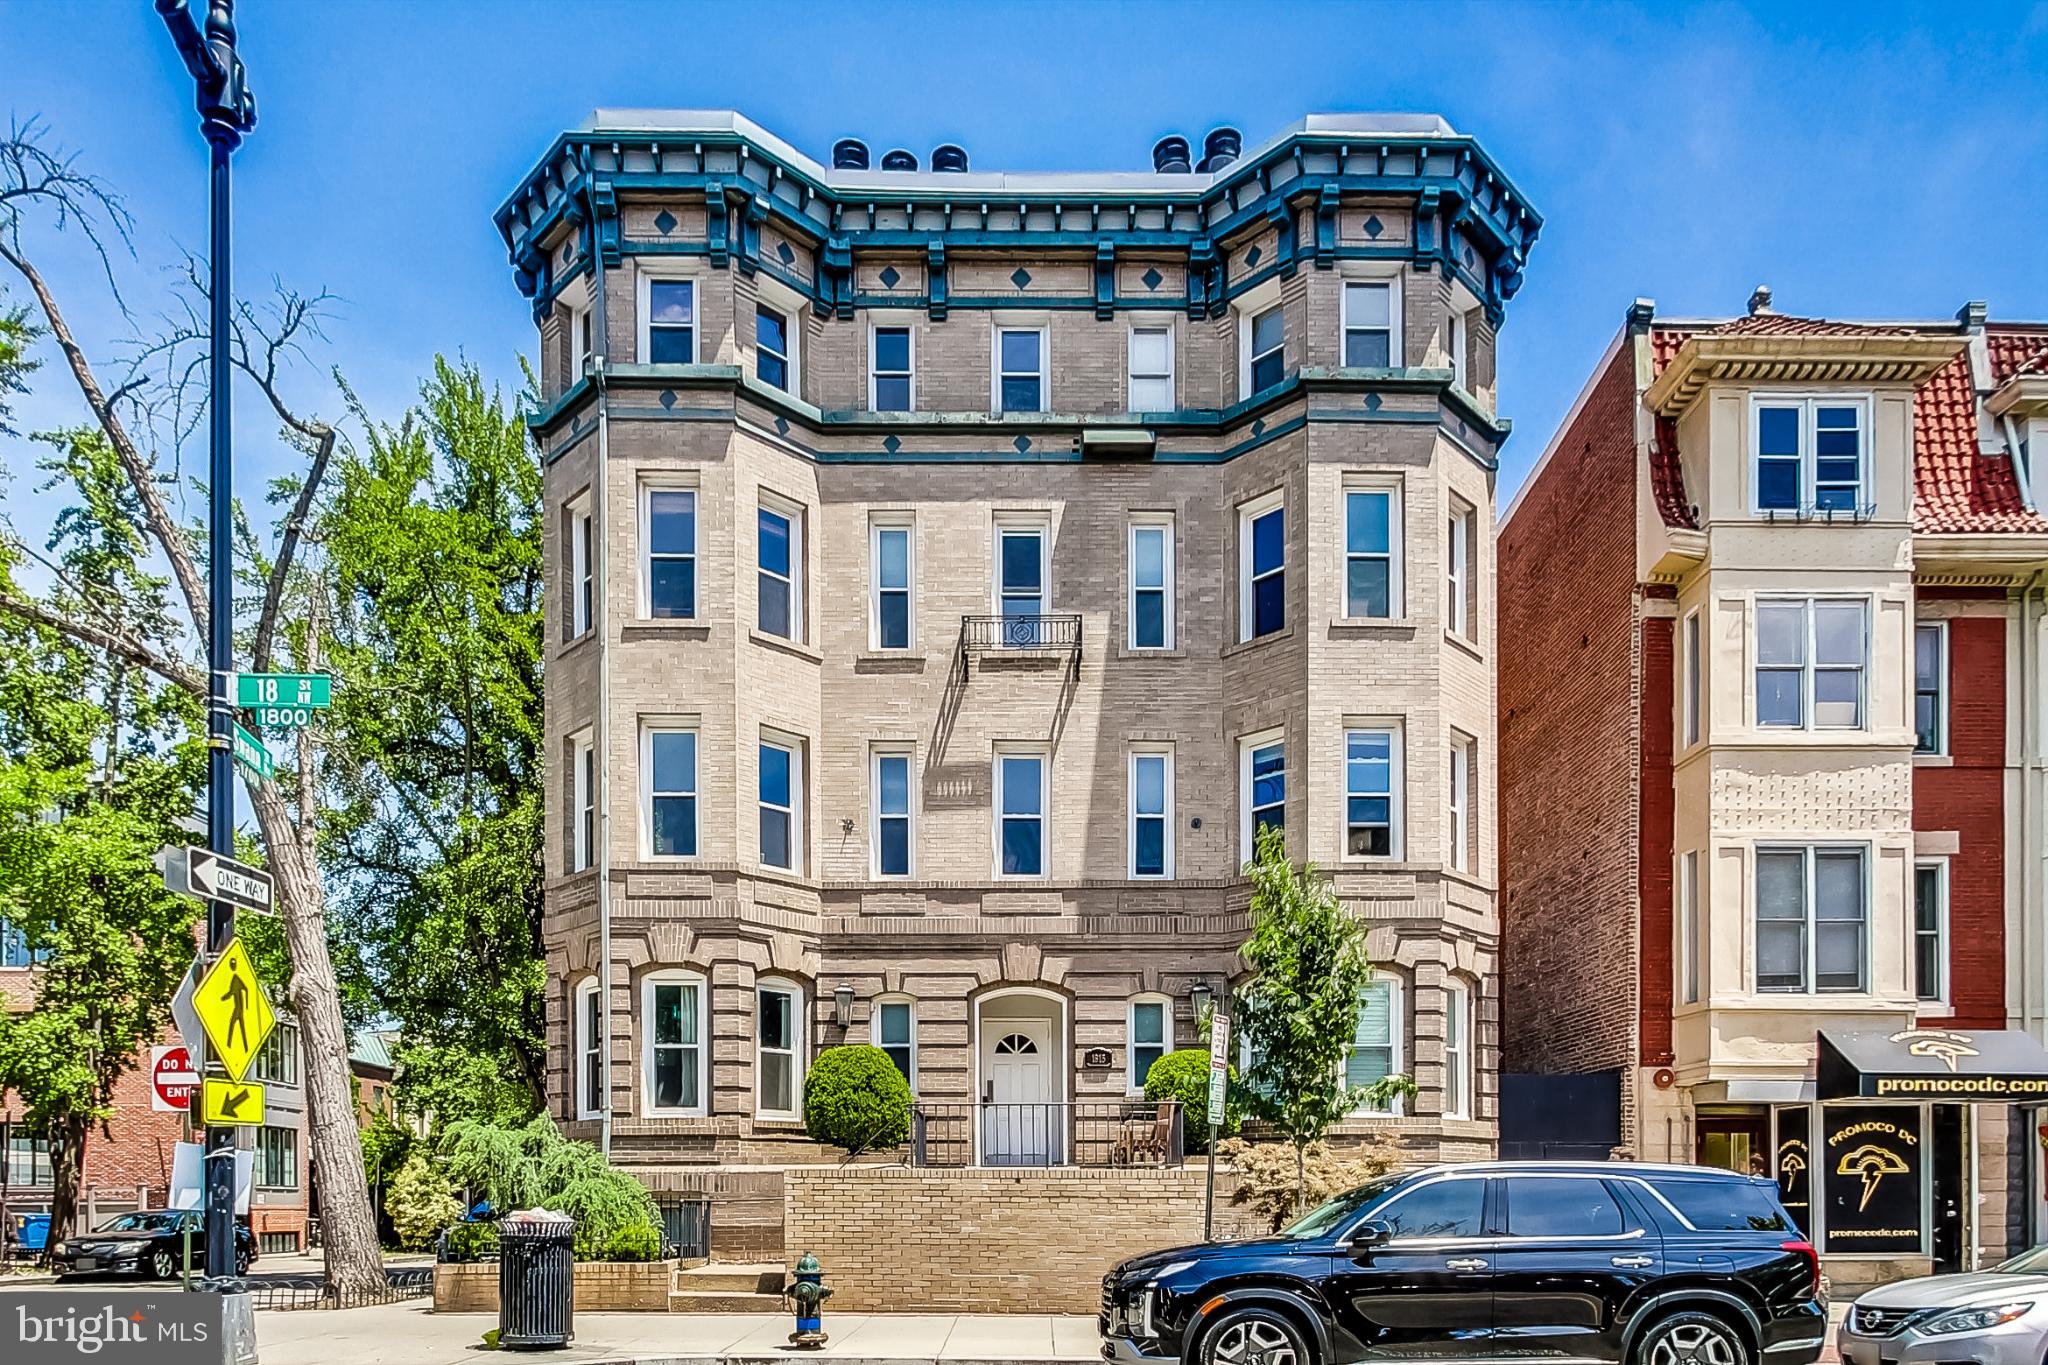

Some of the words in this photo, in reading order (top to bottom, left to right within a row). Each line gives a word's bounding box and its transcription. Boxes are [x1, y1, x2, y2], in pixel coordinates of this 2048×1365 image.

[256, 678, 278, 703] 18
[298, 679, 312, 691] St
[259, 708, 308, 726] 1800
[217, 871, 241, 892] ONE
[243, 879, 265, 900] WAY
[162, 1059, 179, 1070] DO
[167, 1087, 189, 1098] ENT
[1828, 1122, 1896, 1147] PROMOCO
[1898, 1129, 1918, 1146] DC
